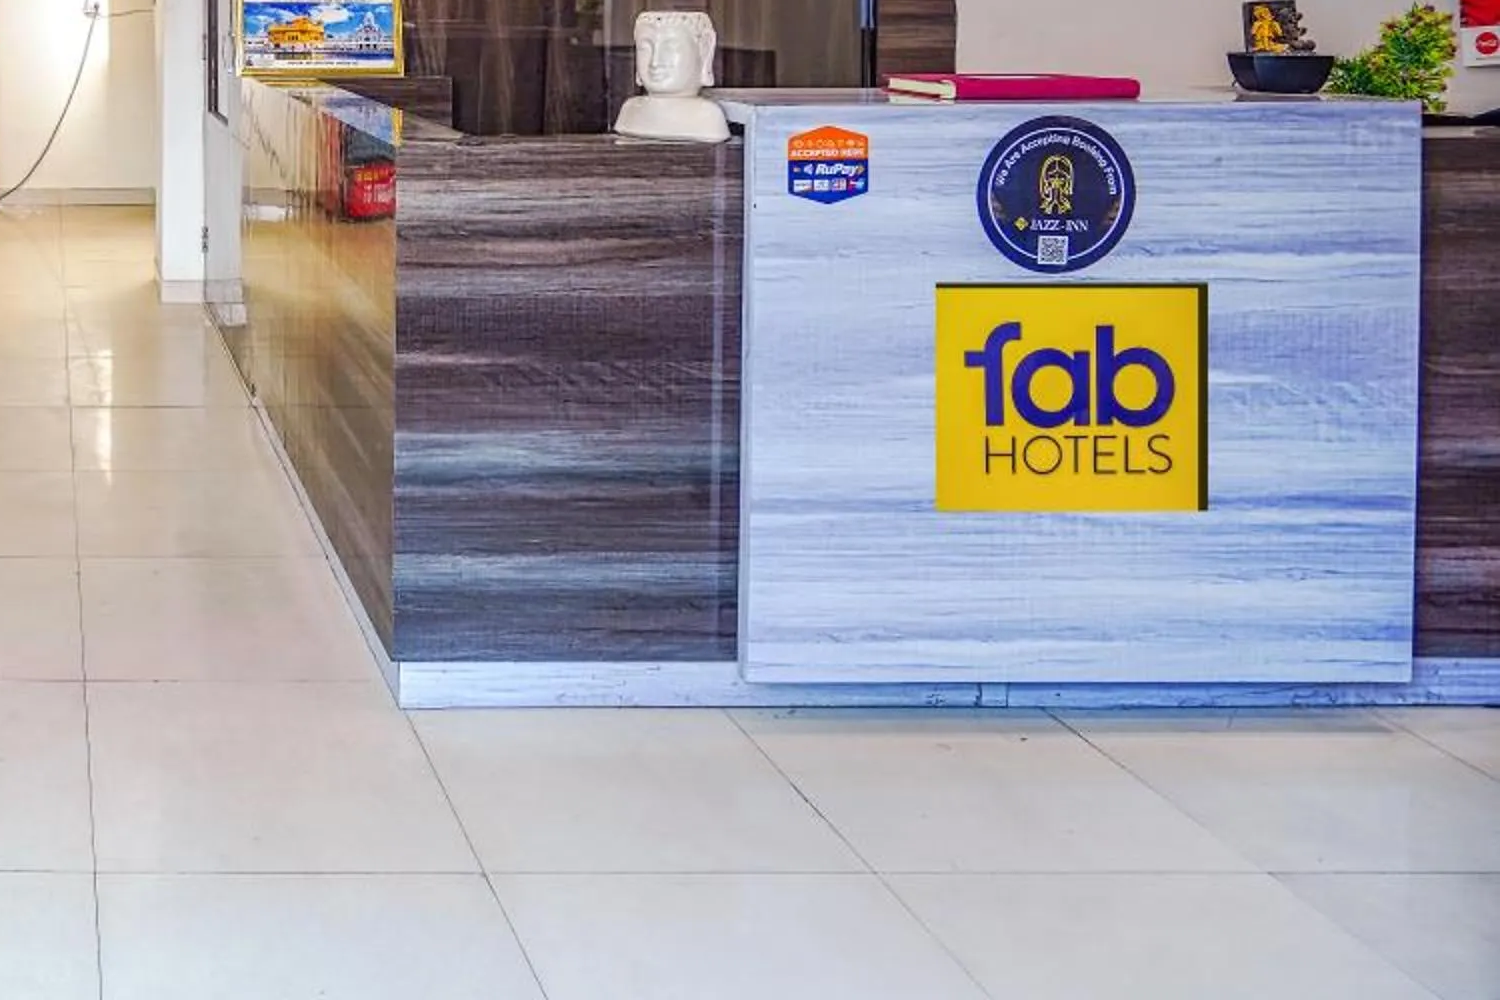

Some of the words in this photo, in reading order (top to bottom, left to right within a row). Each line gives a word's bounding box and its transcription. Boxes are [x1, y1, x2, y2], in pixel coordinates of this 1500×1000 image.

[815, 163, 859, 177] RuPay
[1005, 151, 1021, 169] Are
[1021, 133, 1070, 154] Accepting
[1103, 165, 1117, 195] From
[964, 321, 1176, 428] fab
[985, 434, 1173, 475] HOTELS
